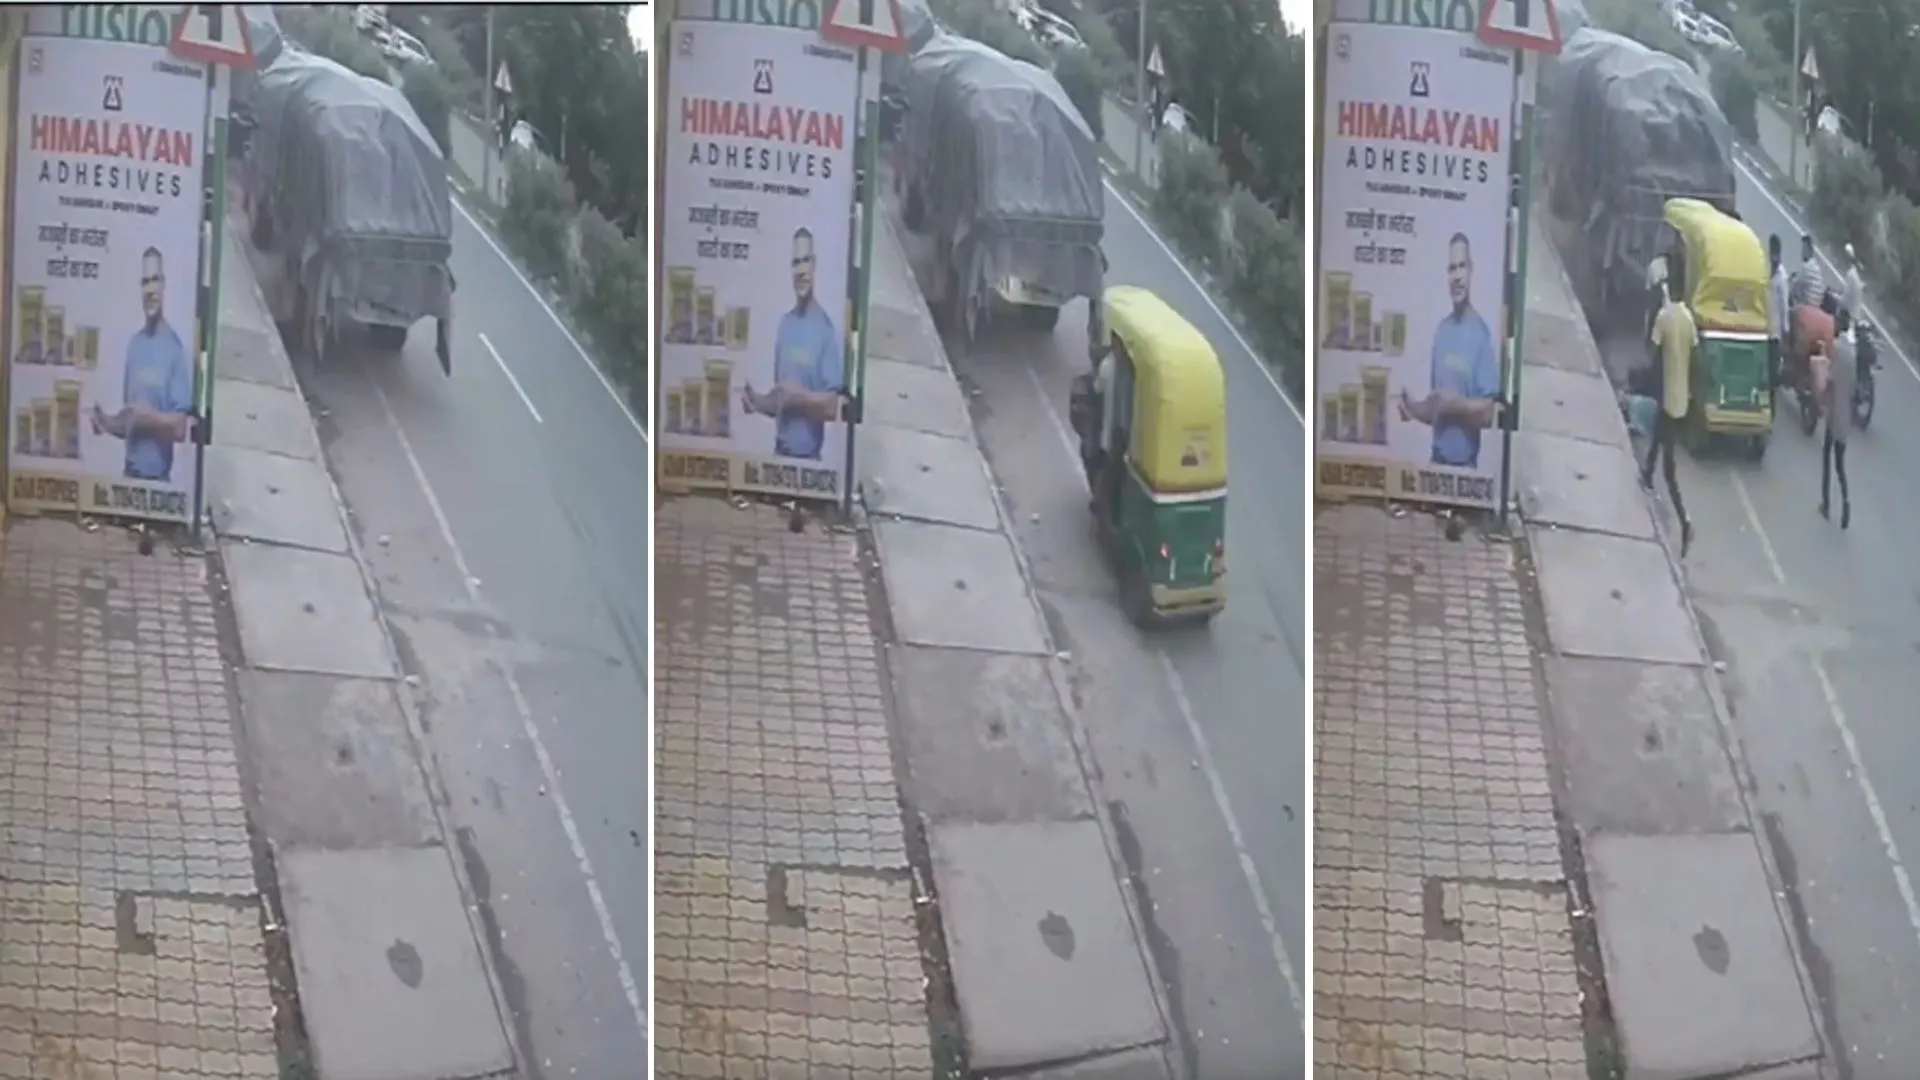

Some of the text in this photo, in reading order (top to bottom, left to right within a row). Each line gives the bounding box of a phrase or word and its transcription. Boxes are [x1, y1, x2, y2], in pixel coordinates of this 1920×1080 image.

[30, 114, 193, 168] HIMALAYAN
[680, 96, 844, 150] HIMALAYAN
[1337, 100, 1500, 154] HIMALAYAN
[38, 159, 183, 198] ADHESIVES
[688, 141, 834, 180] ADHESIVES
[1345, 145, 1490, 184] ADHESIVES
